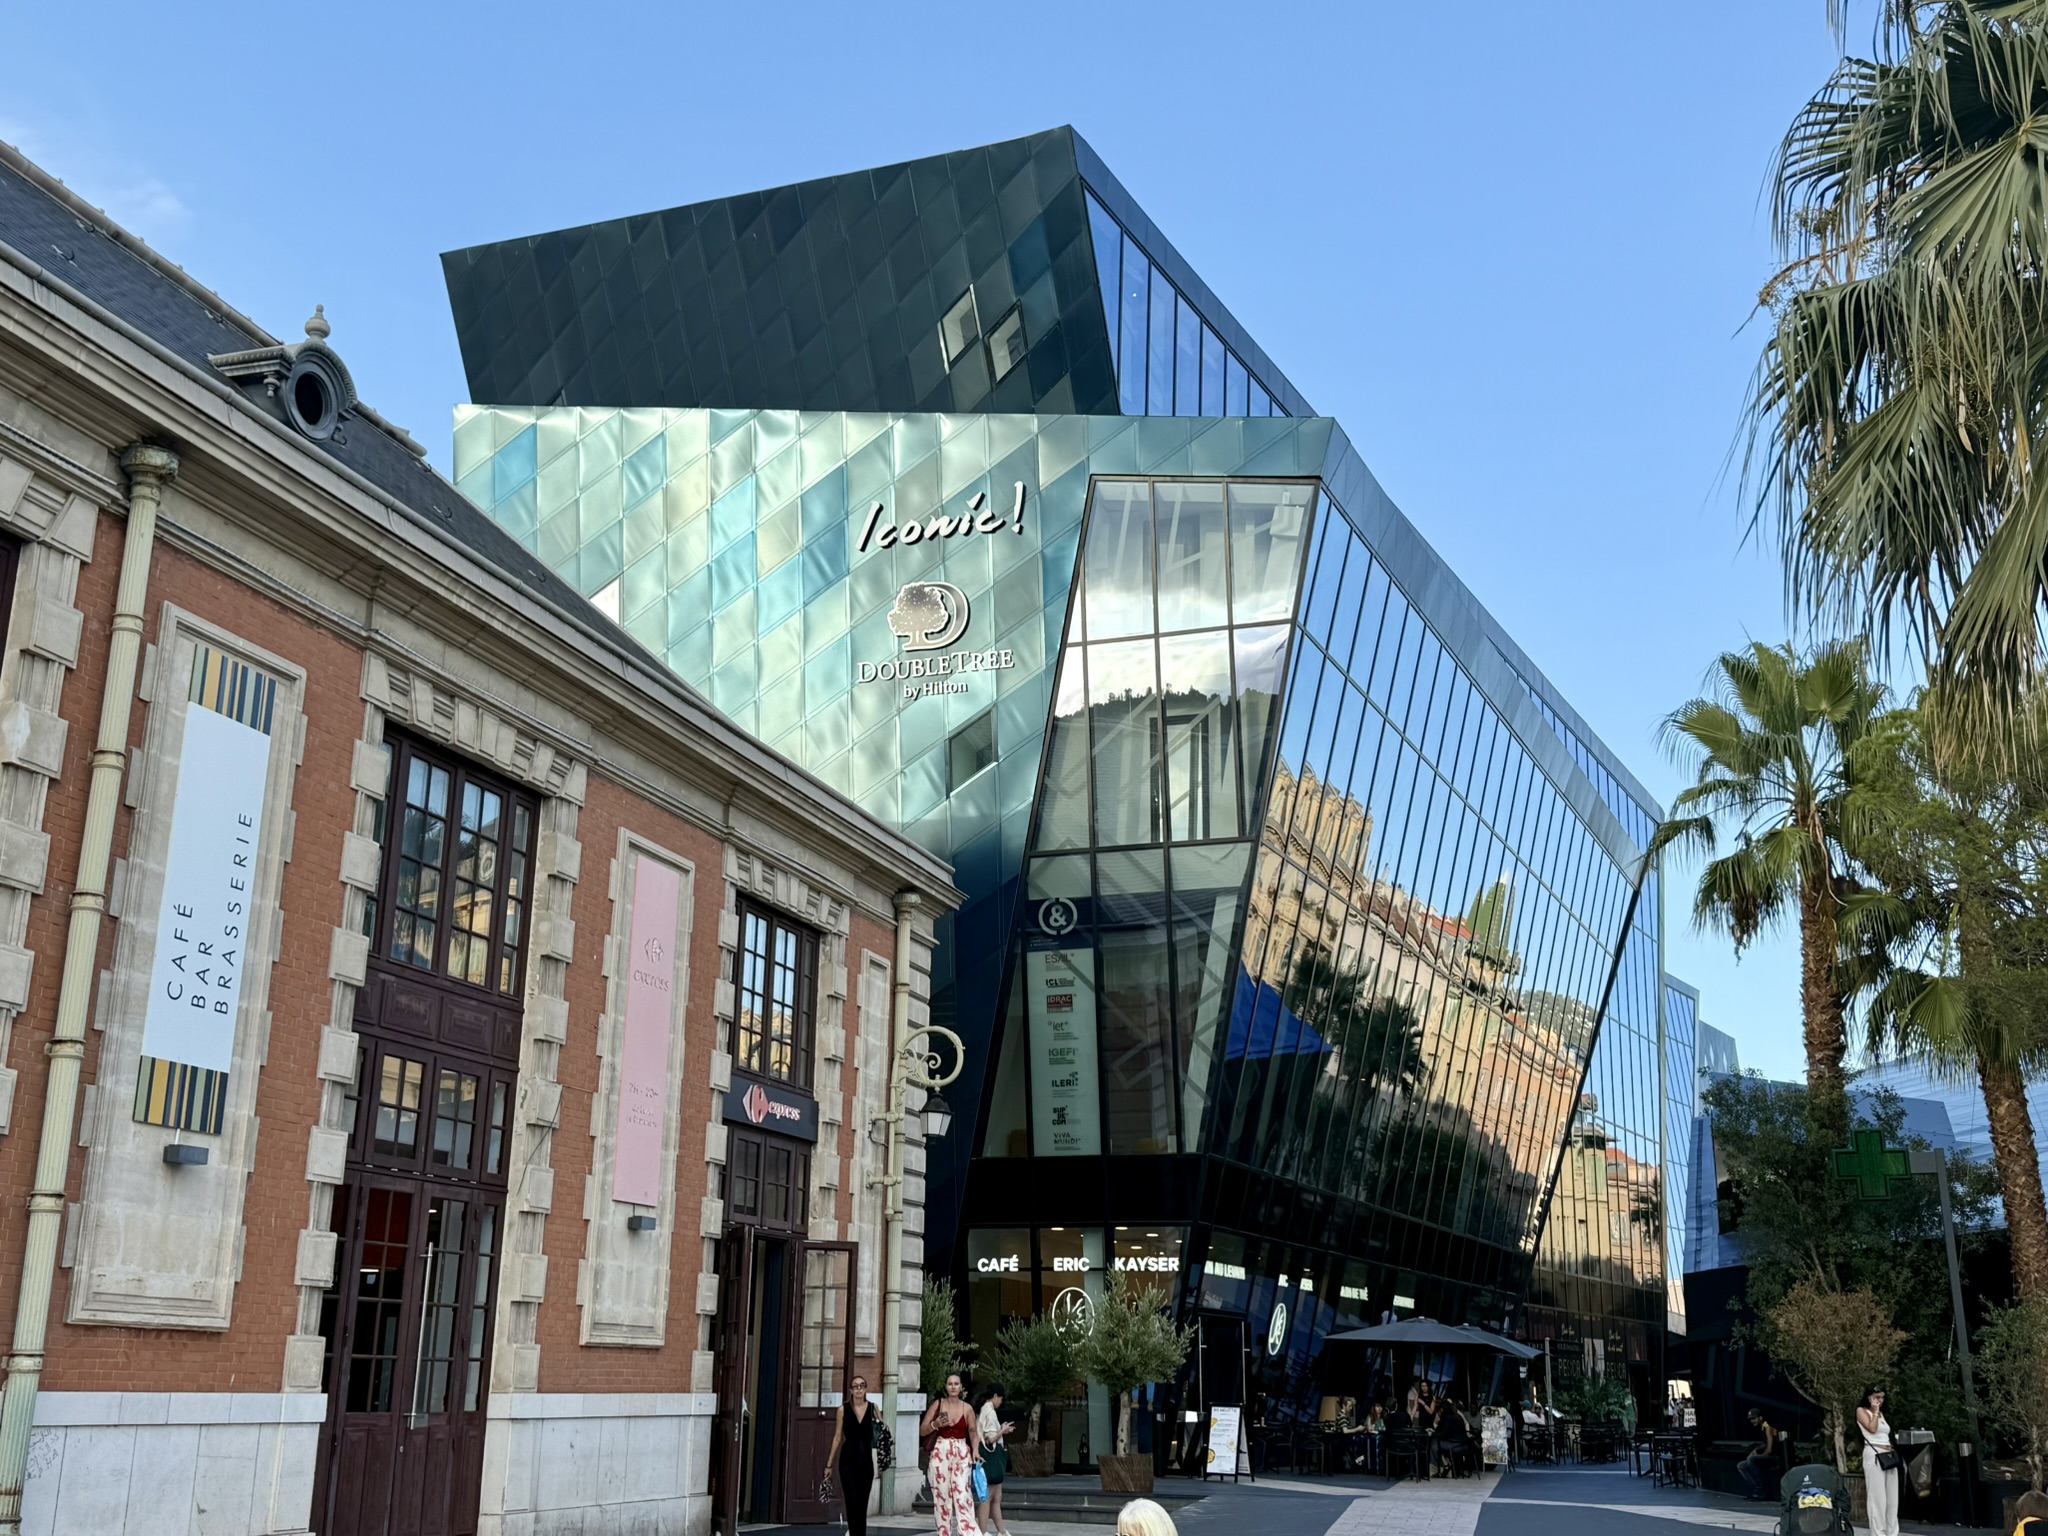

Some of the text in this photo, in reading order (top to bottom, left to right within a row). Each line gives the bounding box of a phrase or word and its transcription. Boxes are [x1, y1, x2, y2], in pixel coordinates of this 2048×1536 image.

[903, 681, 968, 700] by Hilton
[214, 812, 253, 1015] BRASSERIE
[167, 903, 193, 1000] CAFÉ
[191, 941, 214, 1009] BAR
[1047, 994, 1071, 1004] IDRAC
[1049, 1048, 1076, 1057] IGEFI
[1052, 1079, 1075, 1087] ILERI
[769, 1101, 801, 1120] express
[977, 1254, 1180, 1272] CAFÉ ERIC KAYSER
